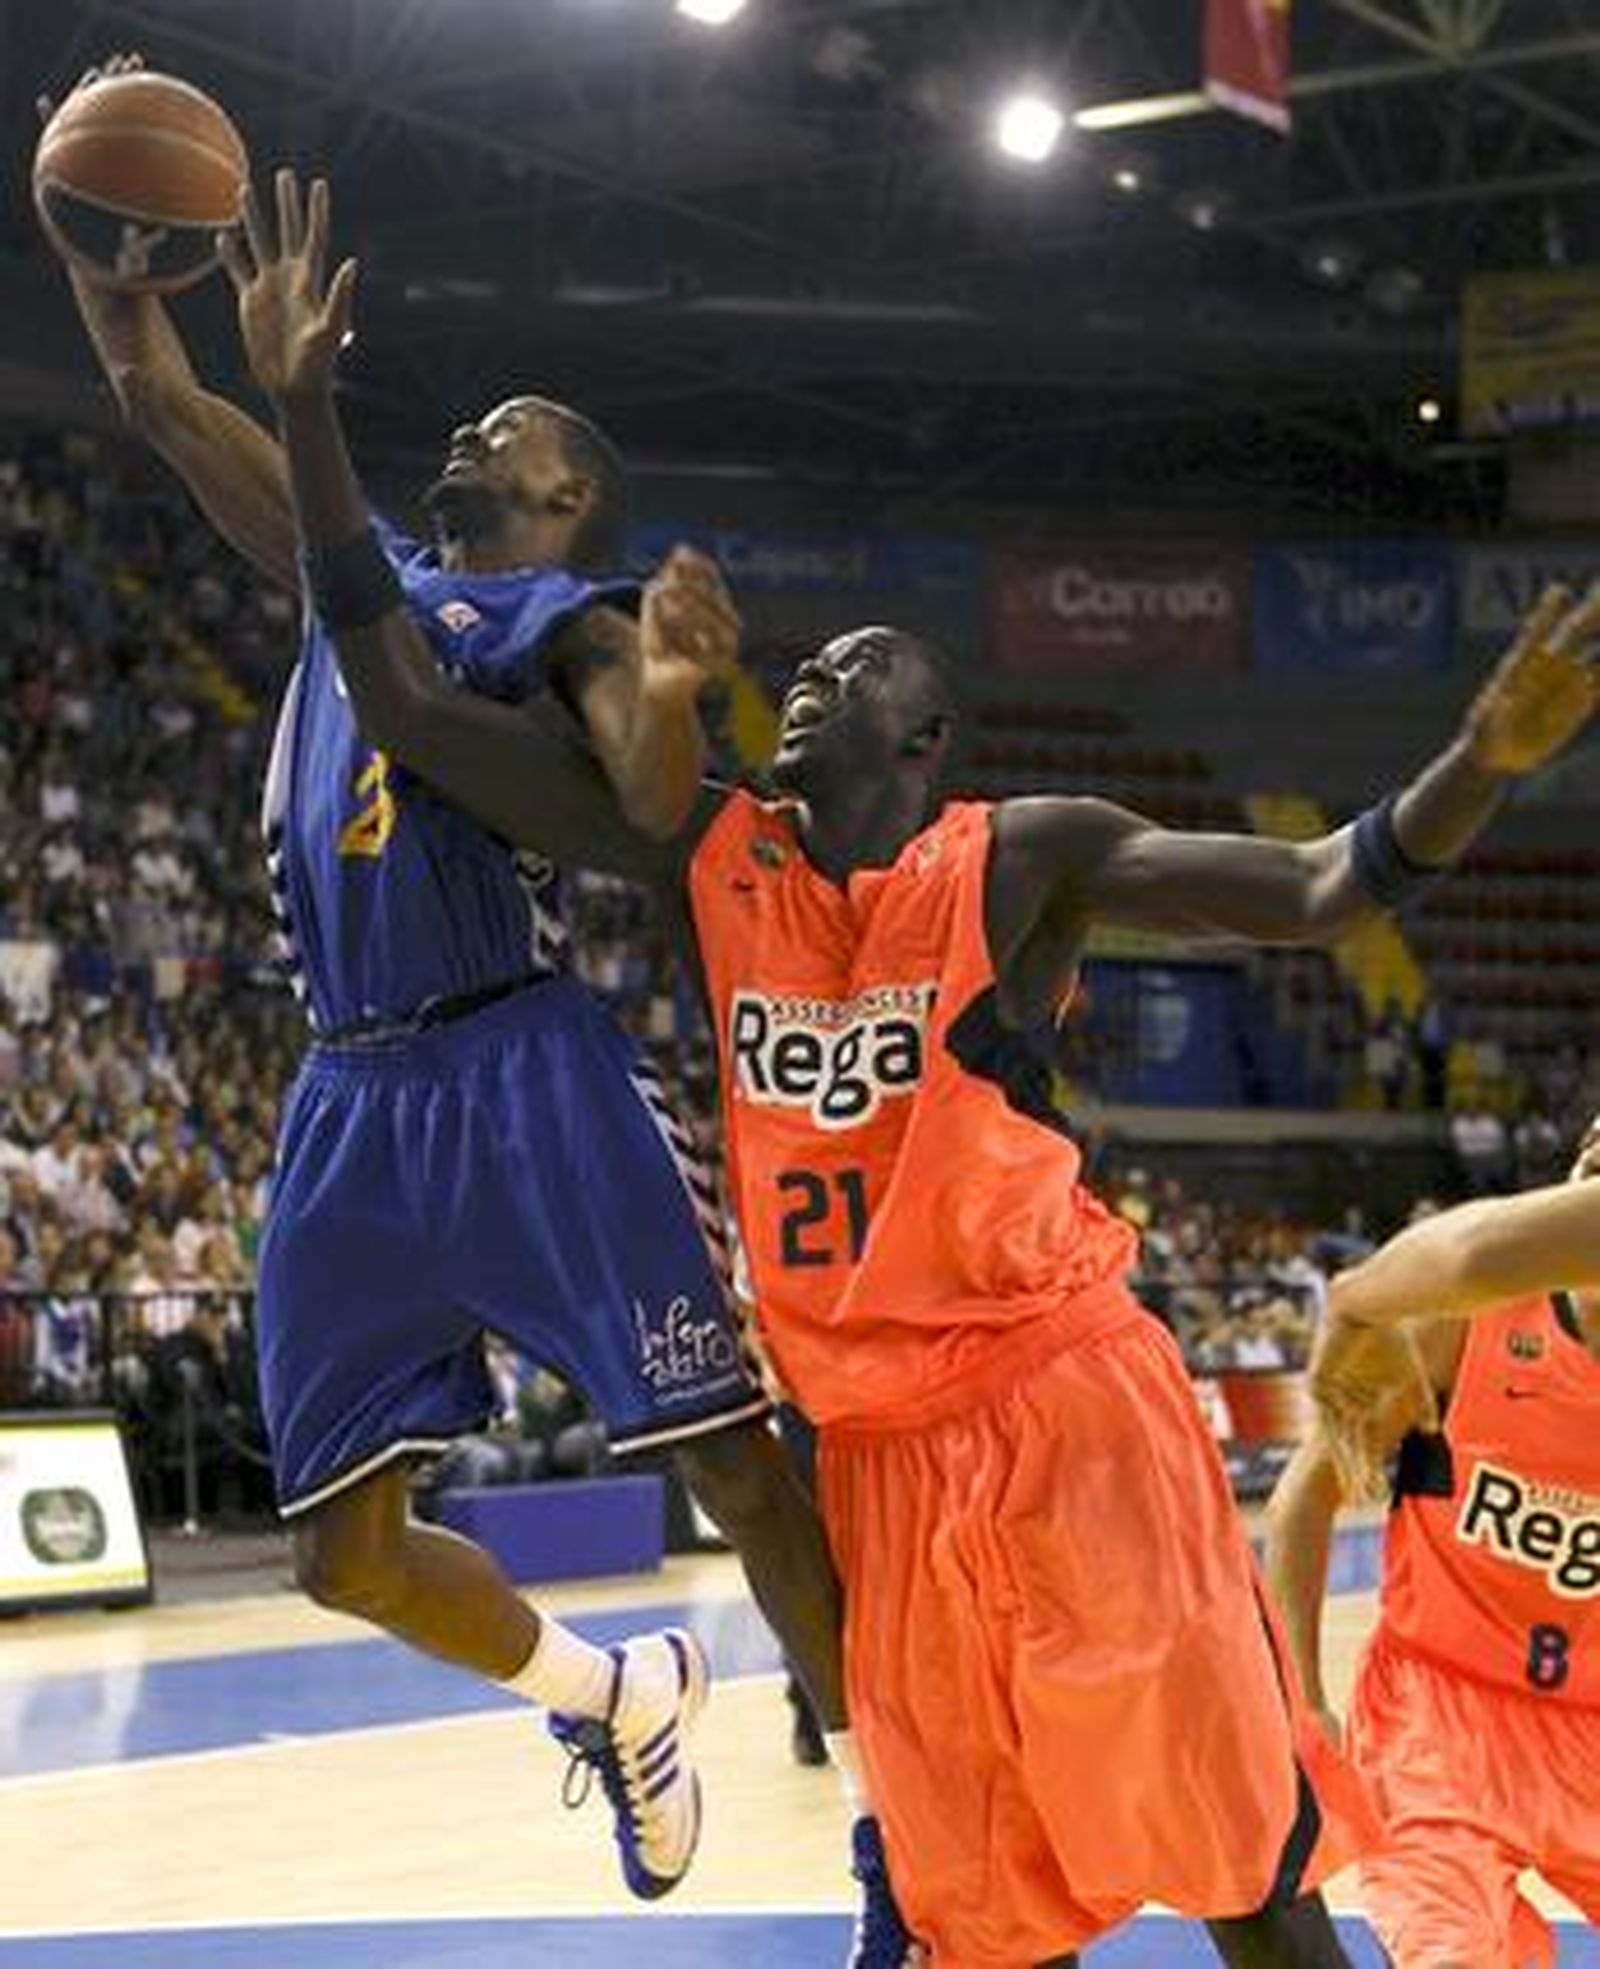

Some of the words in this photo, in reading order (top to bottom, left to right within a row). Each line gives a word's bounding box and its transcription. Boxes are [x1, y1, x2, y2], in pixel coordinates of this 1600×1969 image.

[735, 998, 923, 1120] Rega
[774, 1169, 870, 1269] 21
[1526, 1621, 1570, 1694] 8
